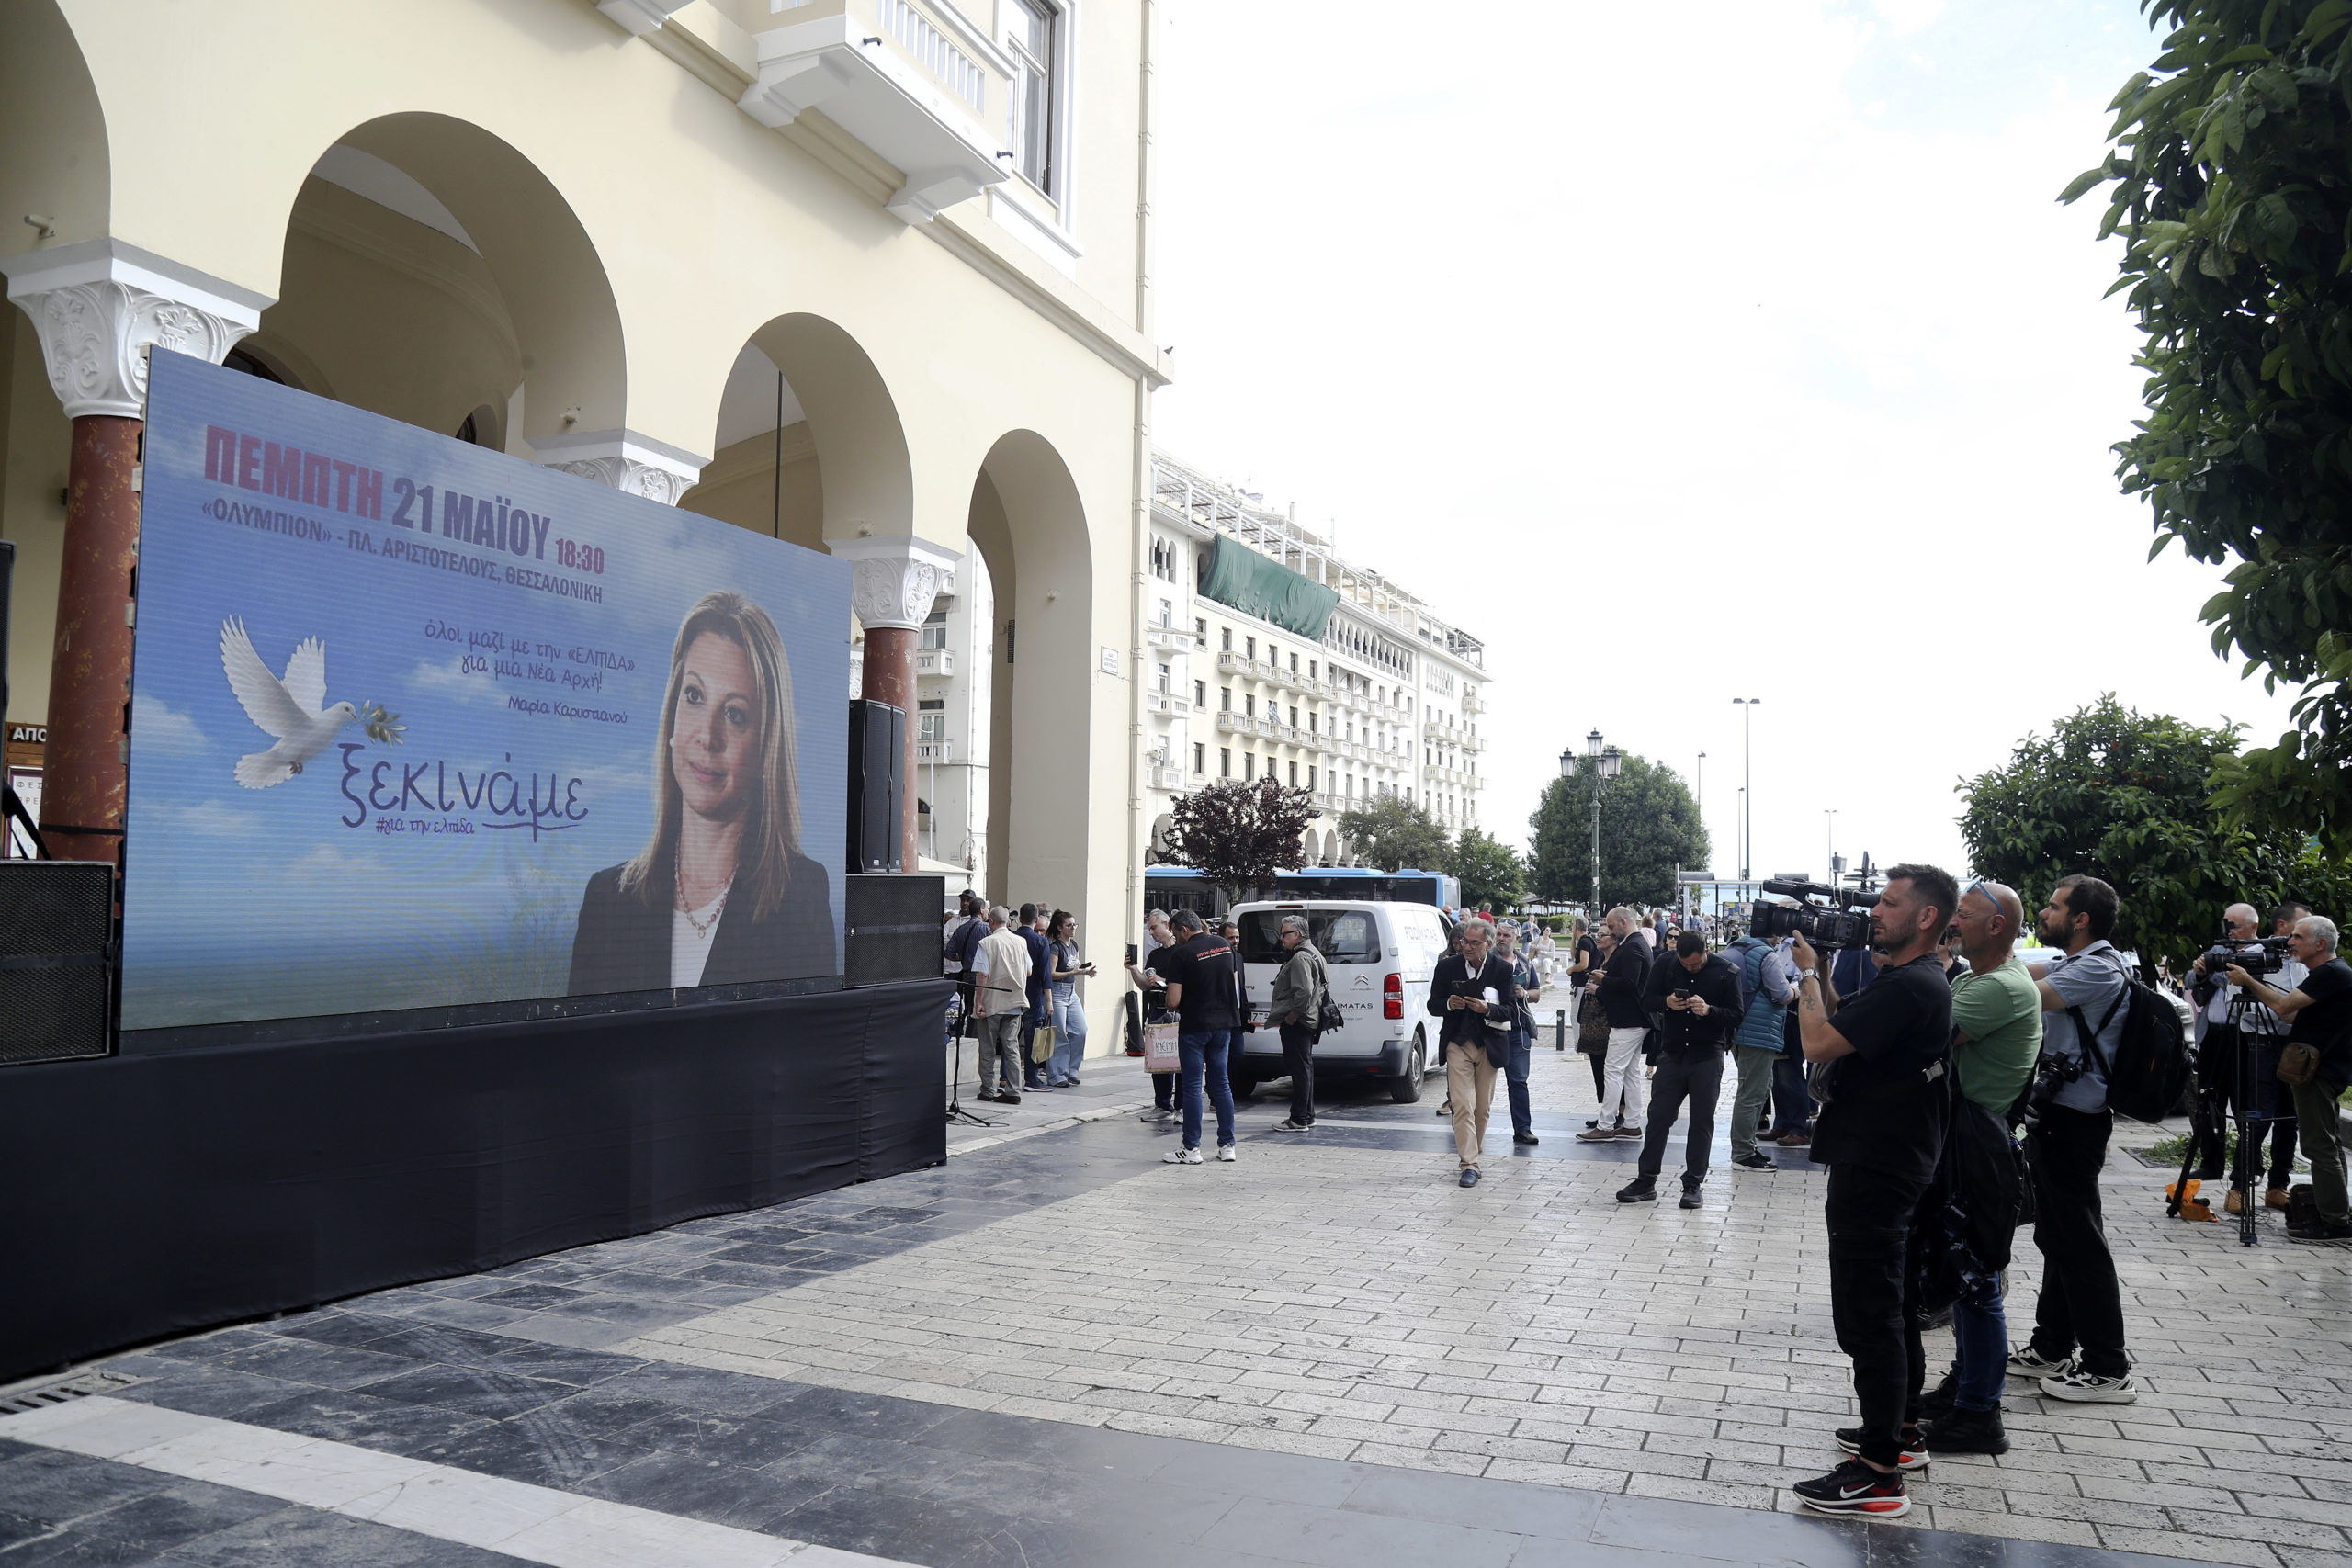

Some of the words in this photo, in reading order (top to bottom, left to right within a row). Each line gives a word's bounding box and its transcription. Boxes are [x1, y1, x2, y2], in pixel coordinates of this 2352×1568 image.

[205, 424, 383, 521] ΠΕΜΠΤΗ
[392, 477, 434, 534] 21
[443, 495, 551, 560] ΜΑΪΟΥ
[555, 537, 605, 575] 18:30
[202, 497, 332, 542] «ΟΛΥΜΠΙΟΝ»
[348, 528, 378, 555] ΠΛ.
[382, 537, 501, 585] ΑΡΙΣΤΟΤΕΛΟΥΣ,
[506, 566, 603, 604] ΘΕΣΣΑΛΟΝΙΚΗ
[425, 618, 463, 643] όλοι
[469, 630, 505, 653] μαζί
[511, 637, 530, 659] με
[537, 643, 561, 663] την
[568, 647, 636, 672] «ΕΛΠΙΔΑ»
[461, 653, 488, 675] για
[494, 658, 522, 681] μια
[527, 662, 556, 682] Νέα
[561, 669, 603, 694] Αρχή!
[508, 695, 549, 716] Μαρία
[554, 701, 628, 725] Καρυστιανού
[338, 742, 589, 843] ξεκινάμε
[410, 819, 431, 836] την
[434, 817, 475, 834] ελπίδα
